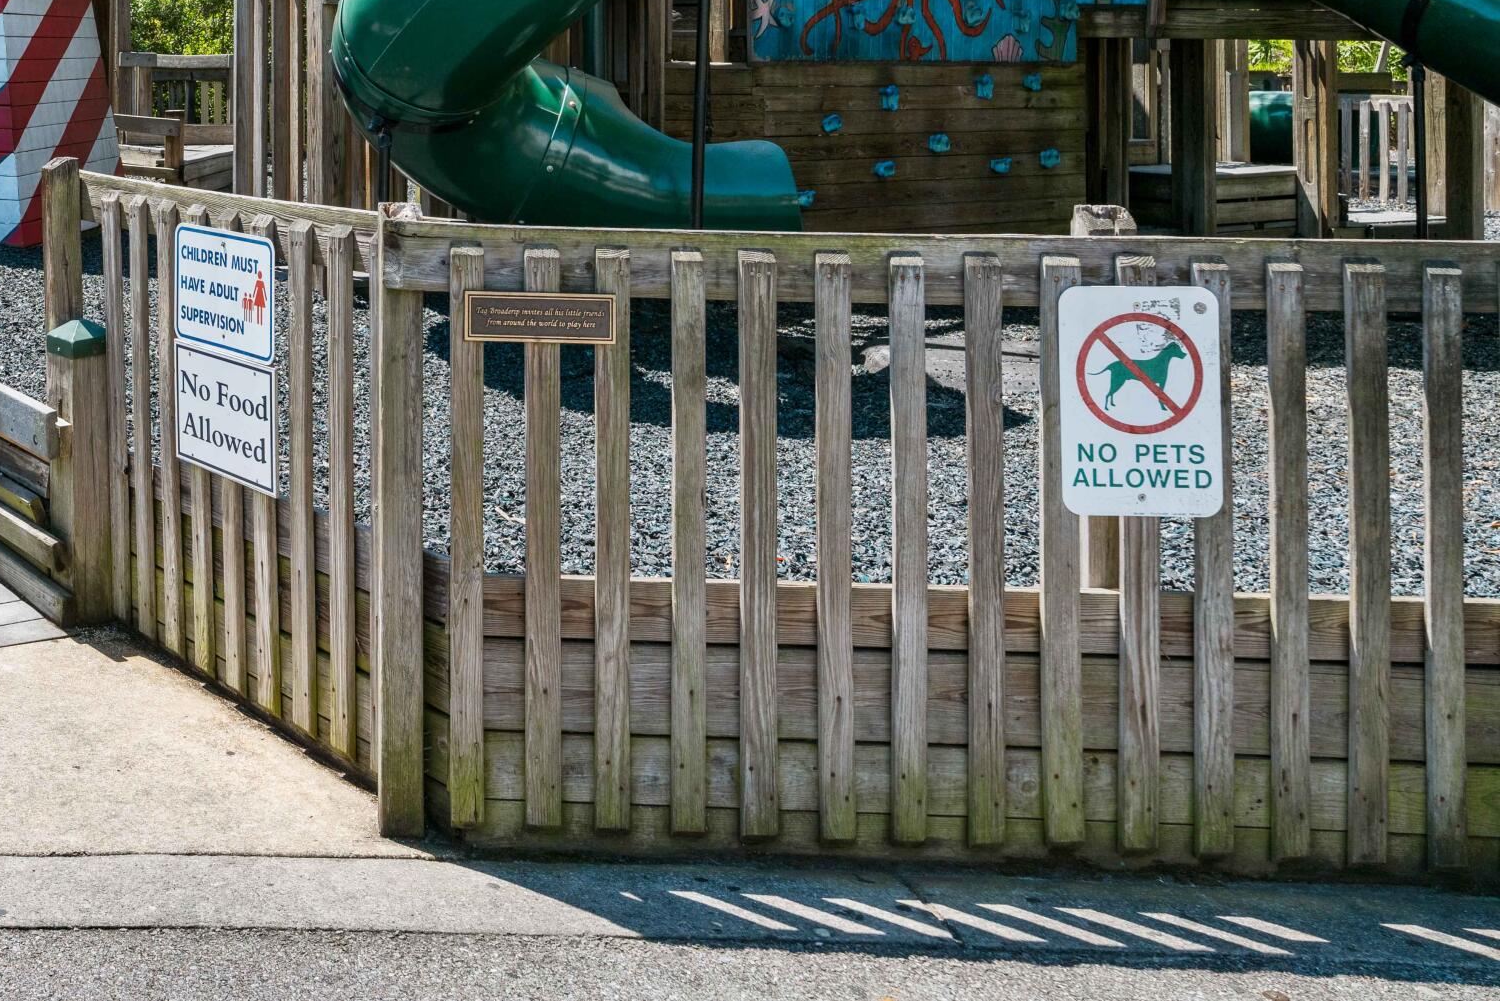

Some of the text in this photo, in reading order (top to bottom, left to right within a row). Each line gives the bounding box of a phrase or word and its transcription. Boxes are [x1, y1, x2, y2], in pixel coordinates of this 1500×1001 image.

[181, 245, 259, 274] CHILDREN MUST
[180, 275, 239, 302] HAVE ADULT
[180, 305, 245, 334] SUPERVISION
[485, 318, 502, 327] from
[538, 319, 559, 327] world
[566, 320, 582, 329] play
[582, 320, 596, 328] here
[554, 308, 565, 316] his
[581, 310, 605, 318] friends
[180, 369, 268, 421] No Food
[182, 412, 267, 464] Allowed
[1077, 443, 1205, 464] NO PETS
[1072, 467, 1213, 489] ALLOWED
